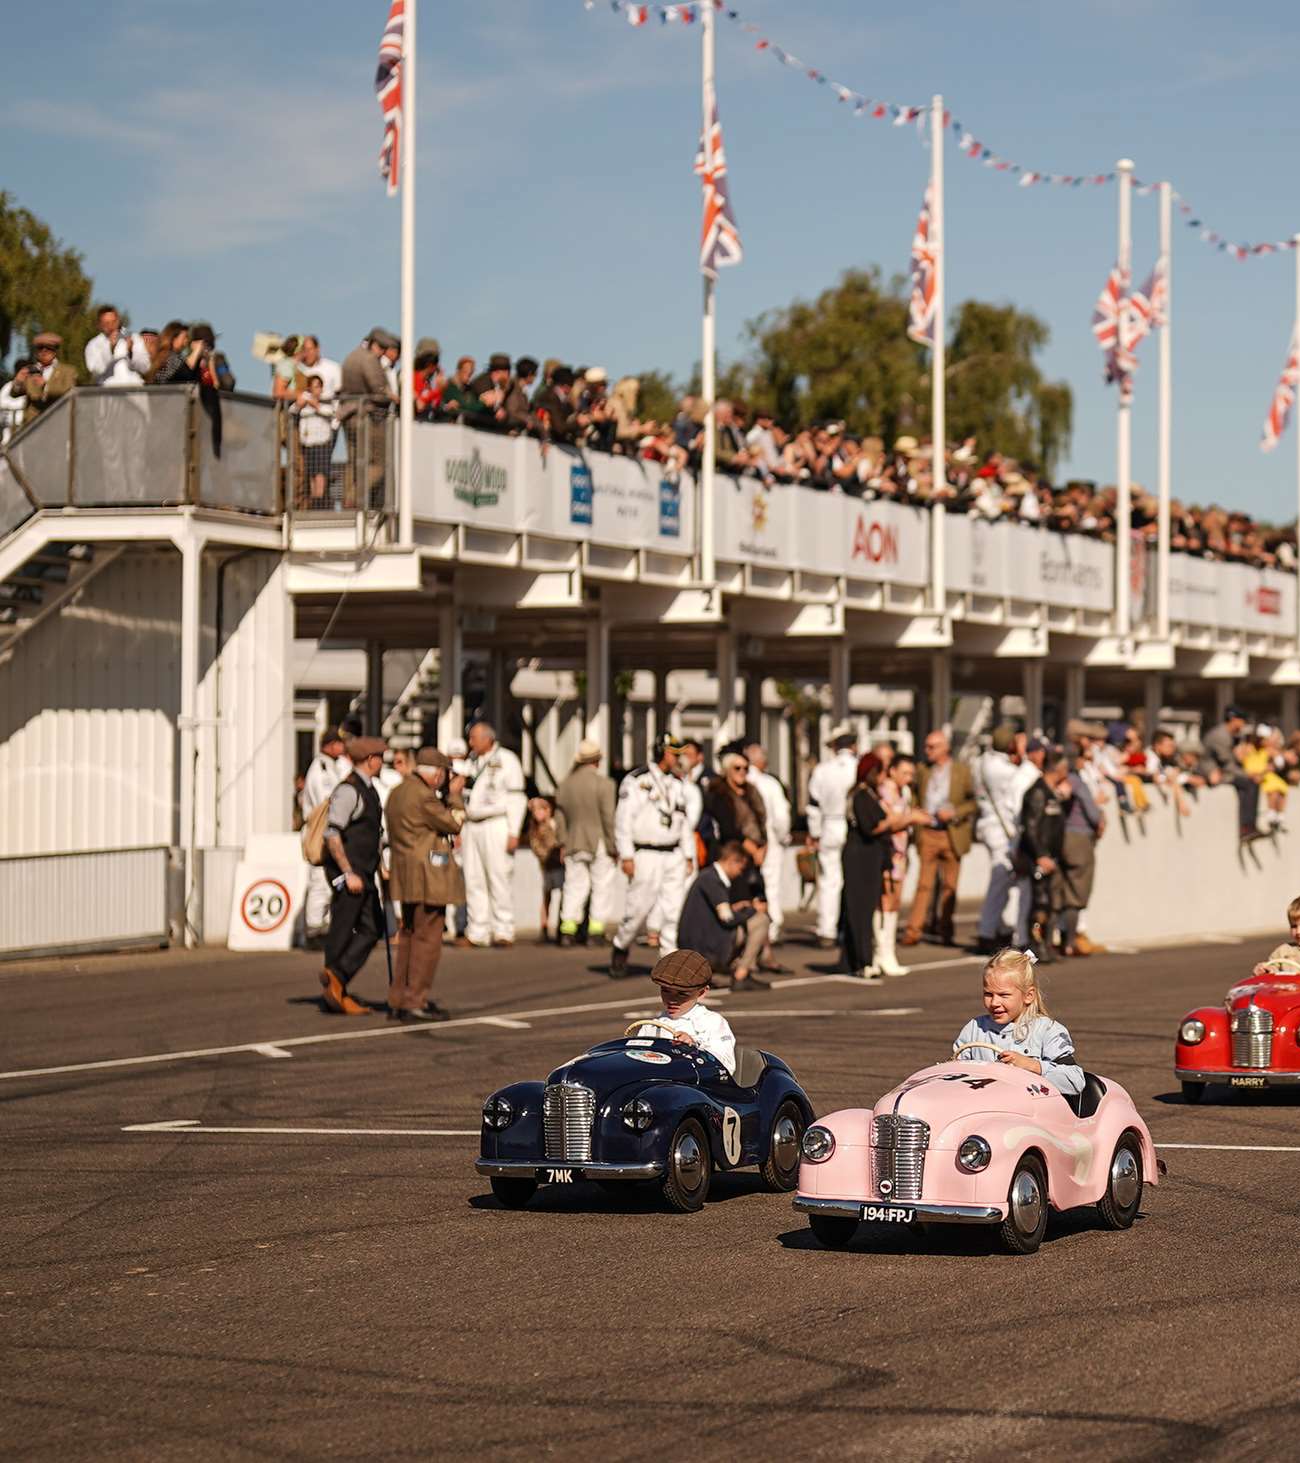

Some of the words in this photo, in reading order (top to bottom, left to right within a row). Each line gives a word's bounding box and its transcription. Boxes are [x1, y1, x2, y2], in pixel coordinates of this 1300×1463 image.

[851, 513, 898, 564] AON
[702, 588, 713, 612] 2
[250, 894, 283, 916] 20
[1231, 1077, 1265, 1087] HARRY
[727, 1116, 737, 1157] 7
[546, 1169, 573, 1183] 7MK
